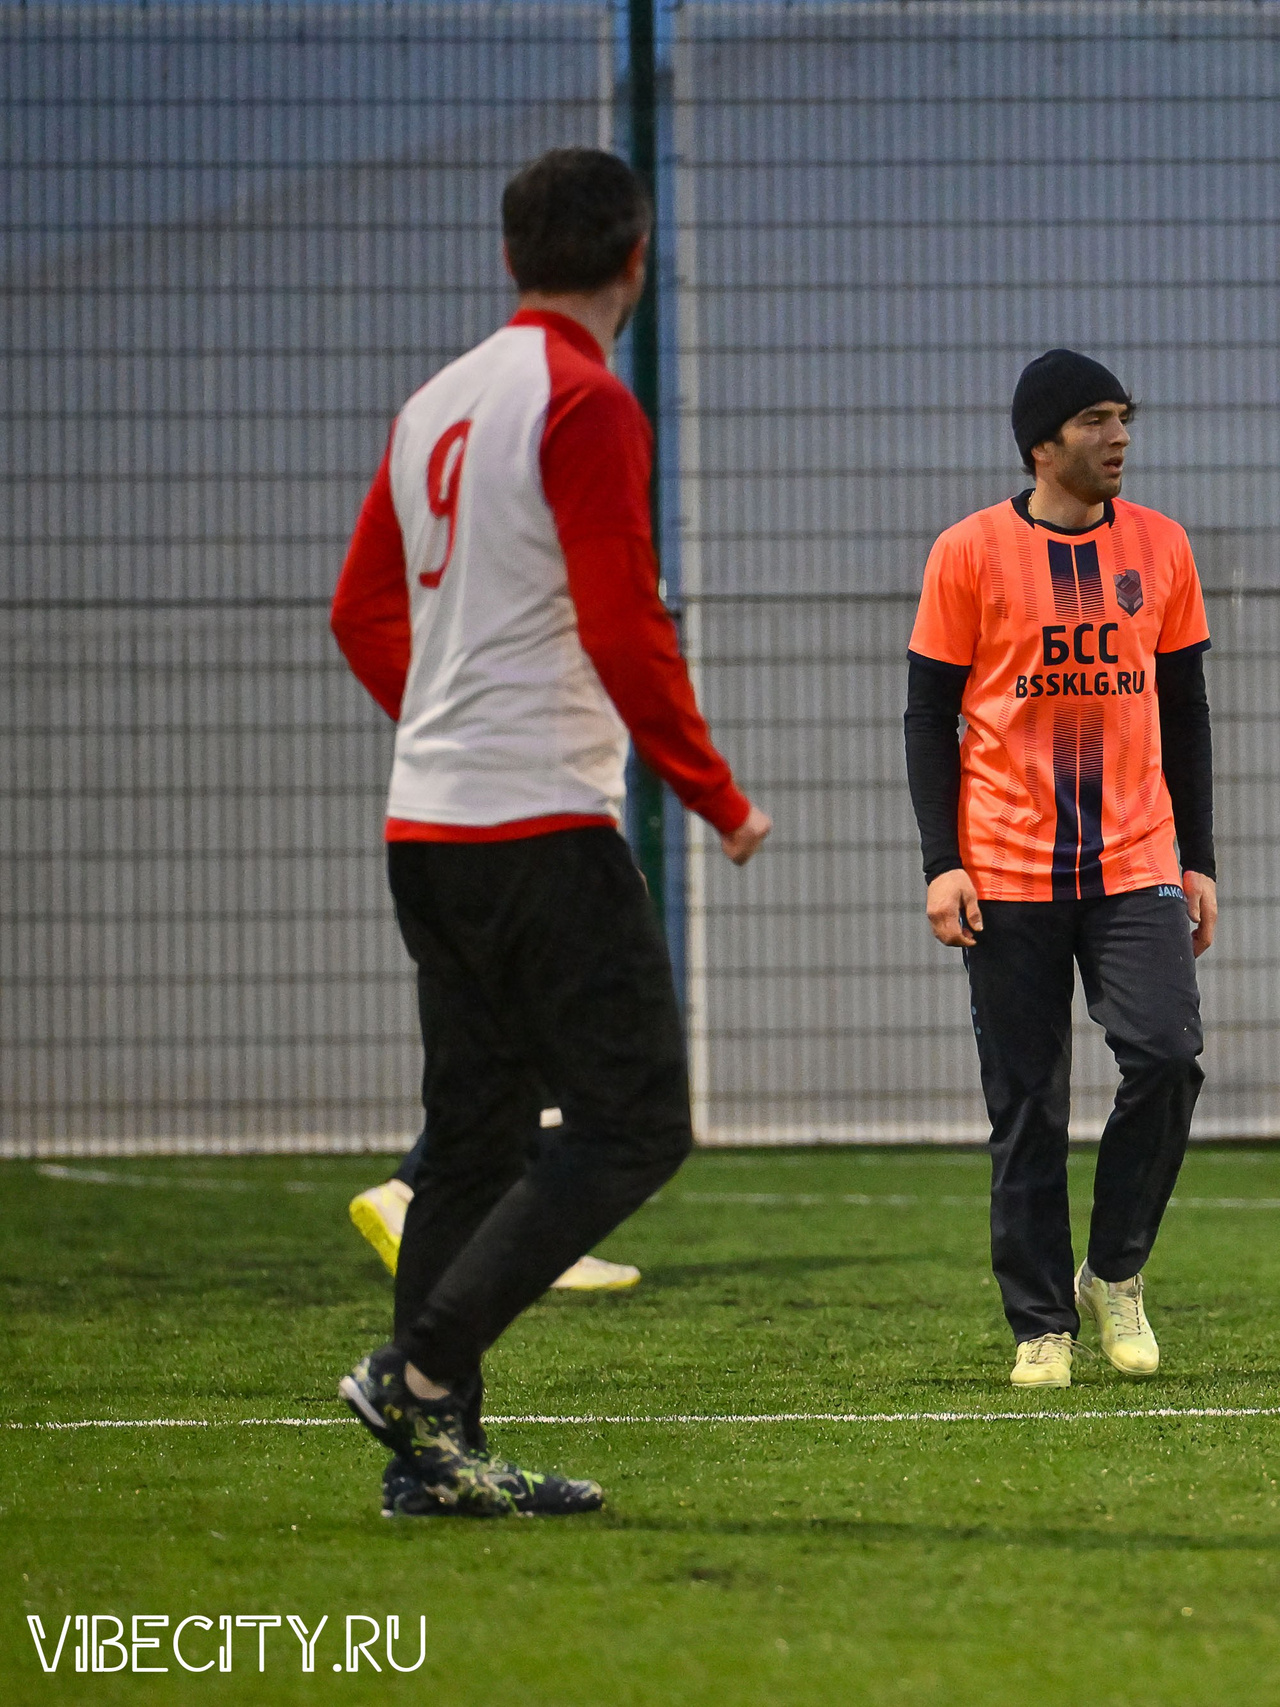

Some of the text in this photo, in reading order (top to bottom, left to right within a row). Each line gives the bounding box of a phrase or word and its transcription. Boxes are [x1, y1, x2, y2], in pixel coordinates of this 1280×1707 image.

[418, 418, 472, 589] 9
[1042, 622, 1119, 667] БСС
[1015, 670, 1145, 699] BSSKLG.RU
